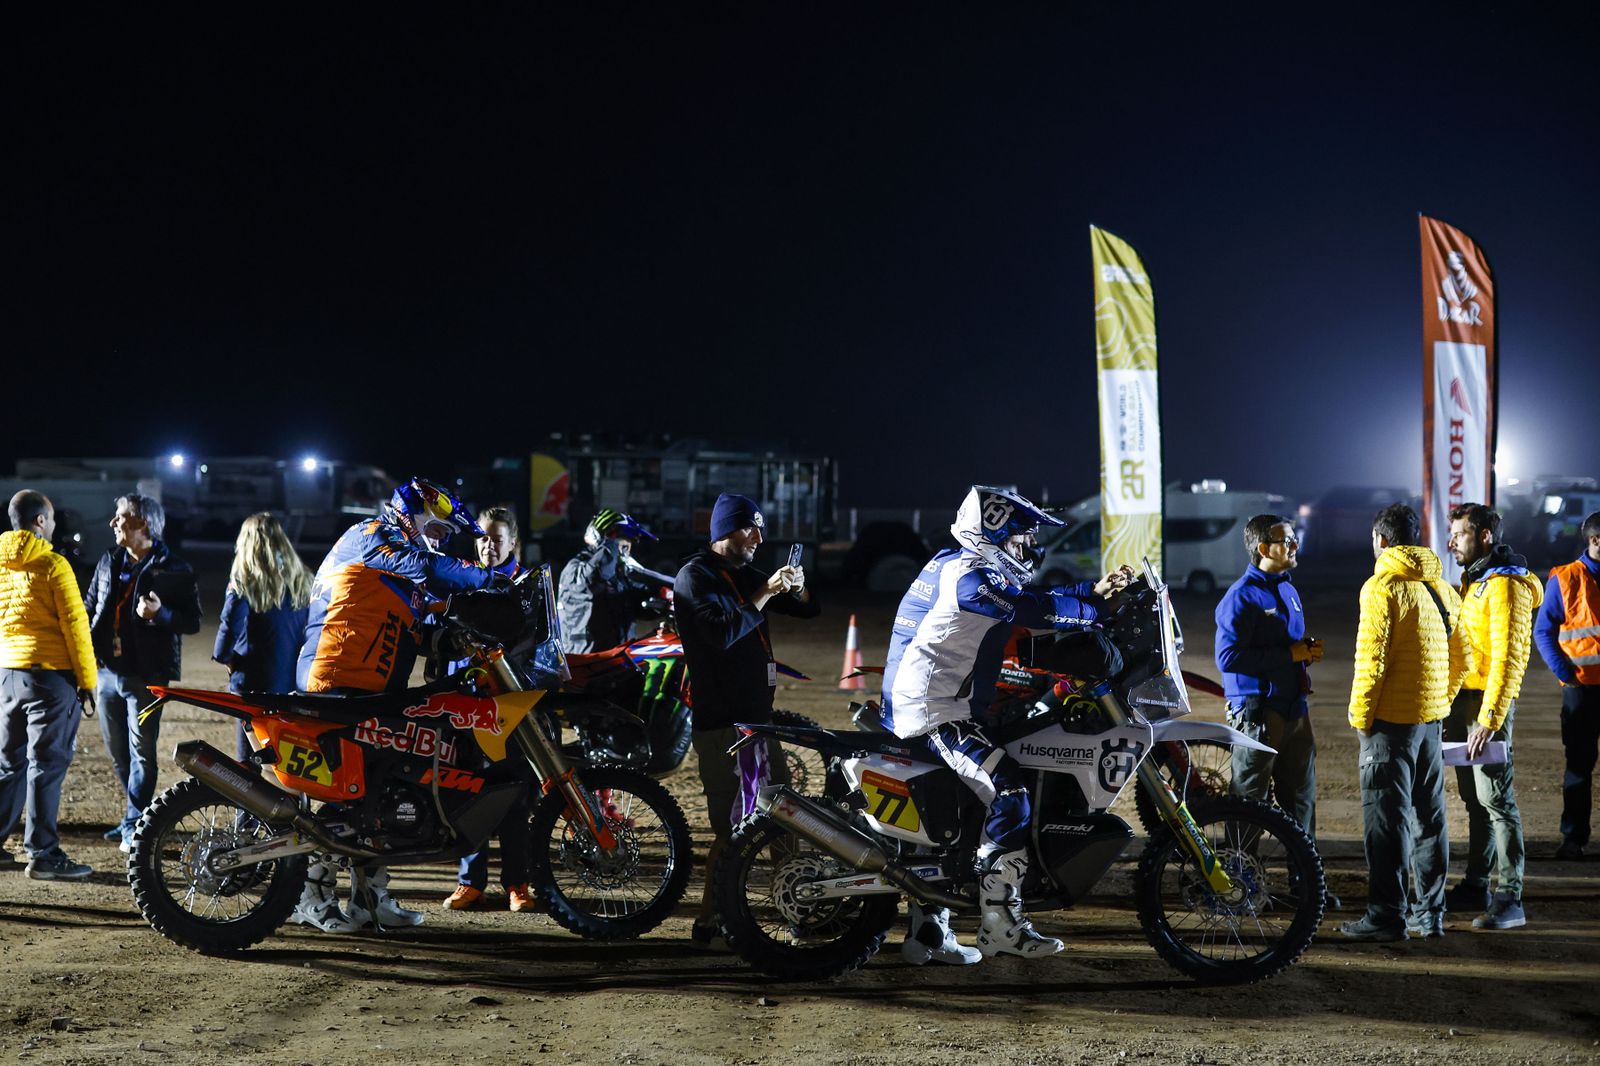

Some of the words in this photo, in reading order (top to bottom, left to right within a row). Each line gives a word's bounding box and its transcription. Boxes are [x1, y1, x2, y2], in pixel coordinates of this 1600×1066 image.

[354, 717, 416, 752] Red
[413, 727, 457, 766] Bul
[1019, 743, 1094, 759] Husqvarna
[286, 745, 323, 782] 52
[420, 766, 486, 794] KTM
[873, 787, 905, 825] 77
[1185, 819, 1211, 857] MOTOREX
